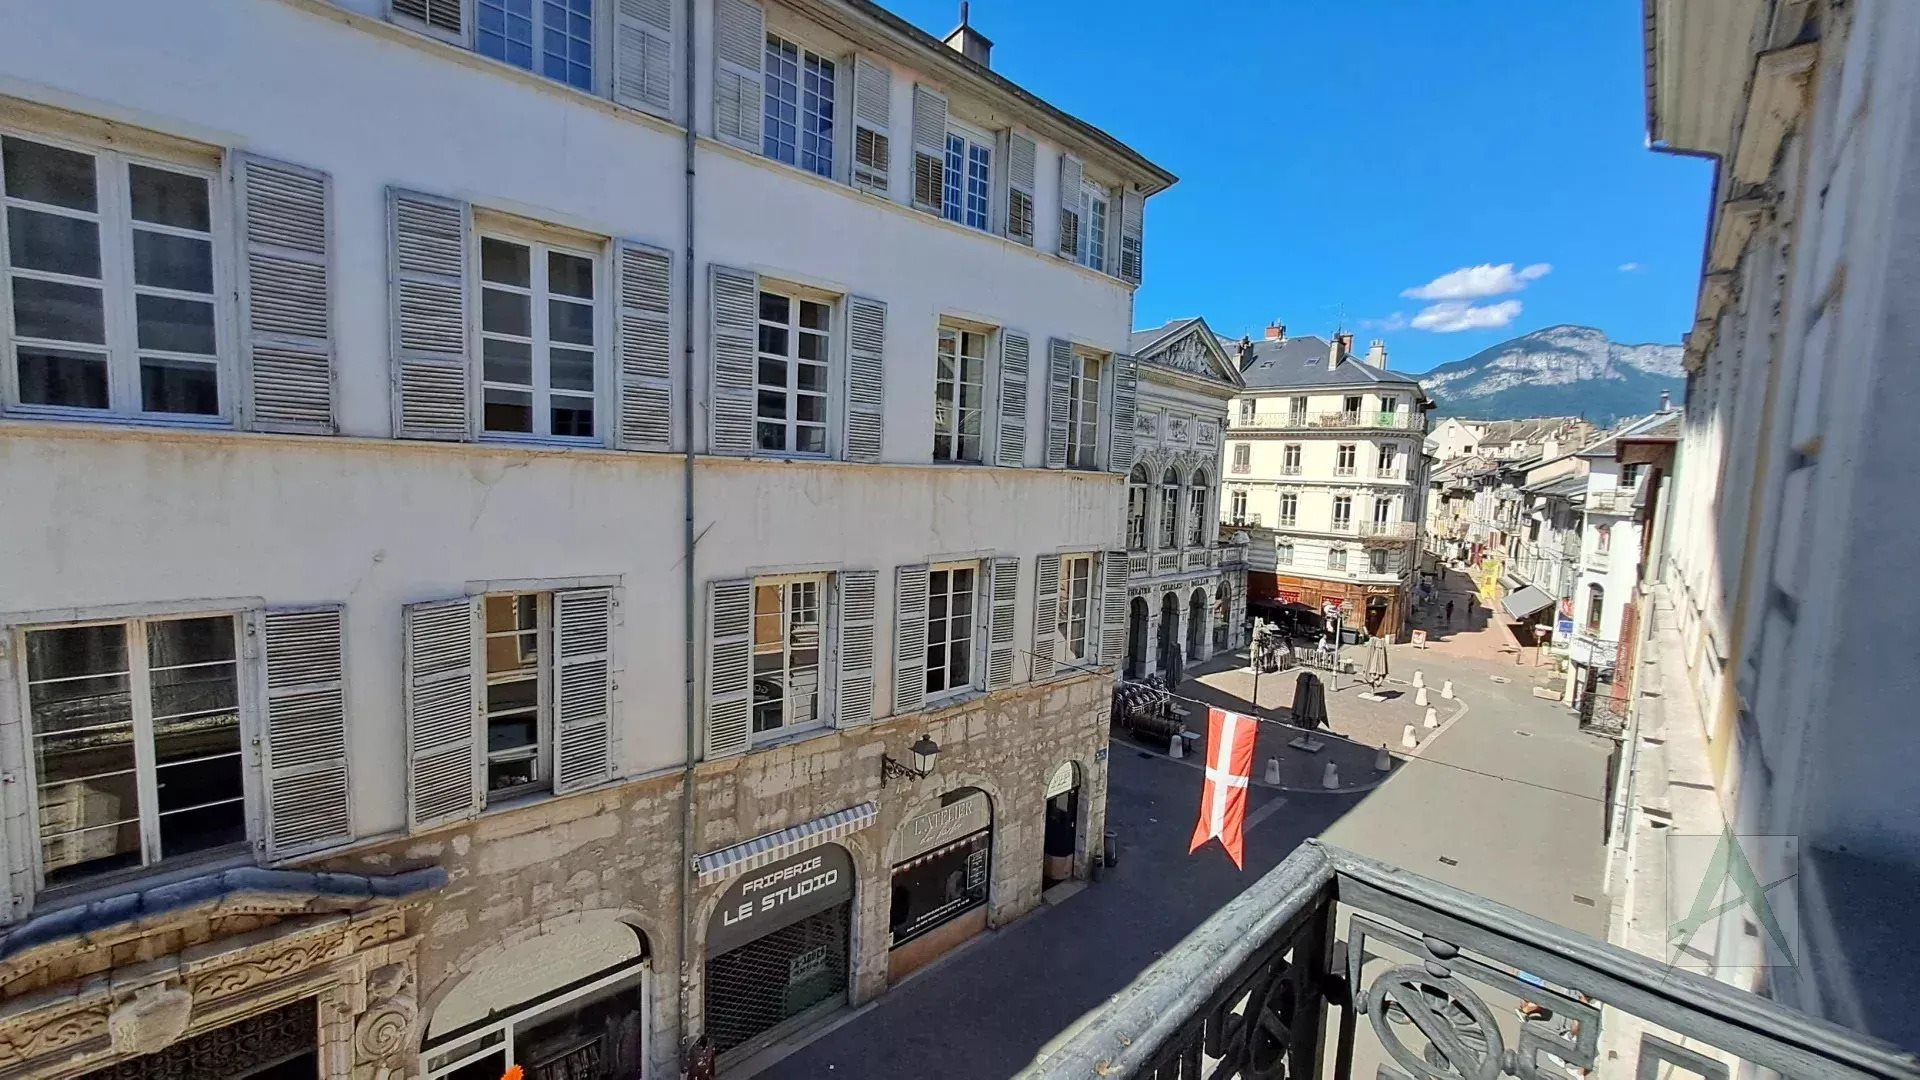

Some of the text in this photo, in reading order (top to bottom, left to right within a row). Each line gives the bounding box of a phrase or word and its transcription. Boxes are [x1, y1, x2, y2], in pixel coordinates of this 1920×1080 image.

[723, 869, 838, 926] LE STUDIO
[742, 856, 822, 896] FRIPERIE
